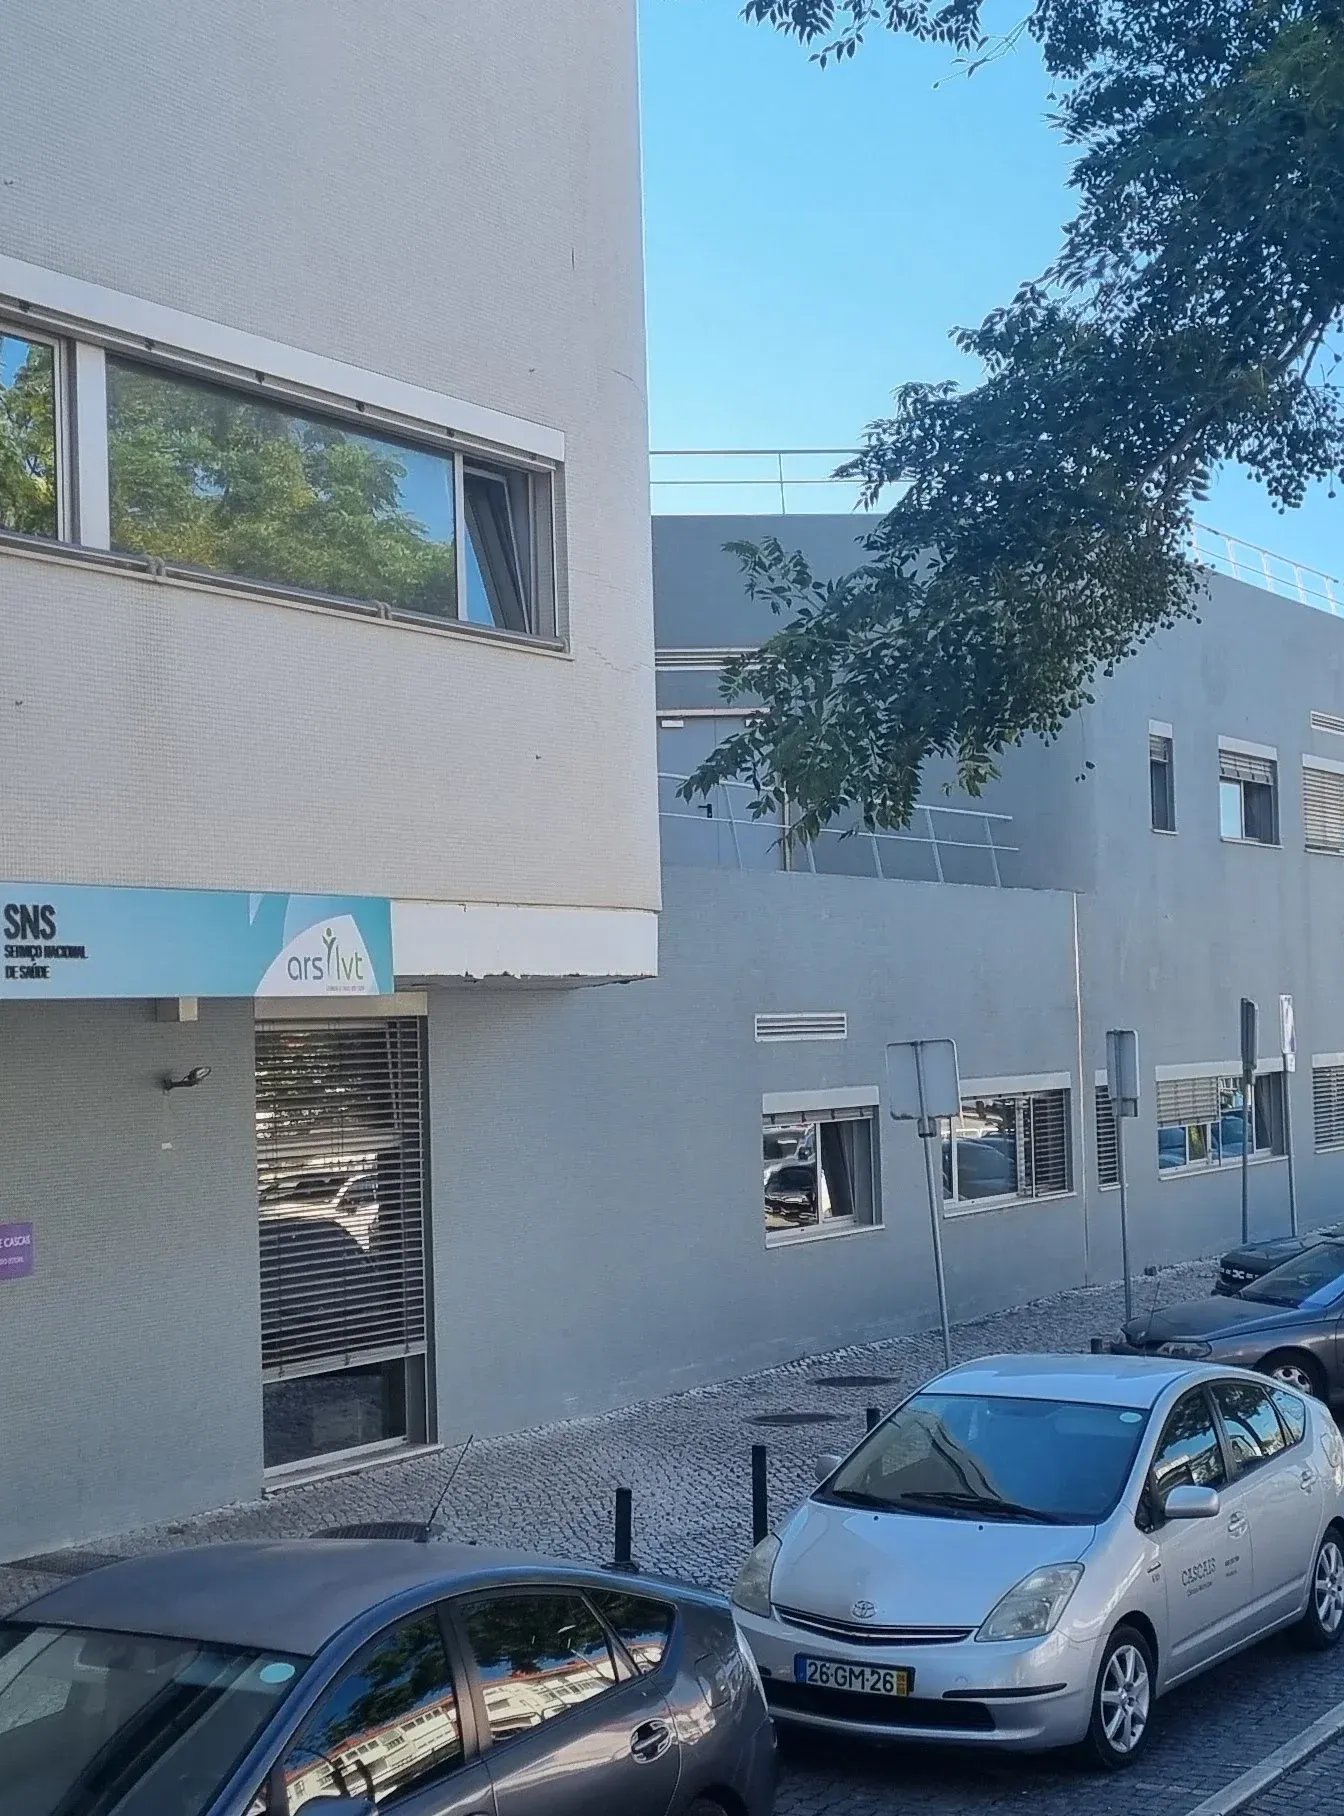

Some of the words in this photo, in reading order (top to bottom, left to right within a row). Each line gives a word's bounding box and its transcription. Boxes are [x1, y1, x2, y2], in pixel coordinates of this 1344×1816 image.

[3, 903, 57, 941] SNS
[4, 944, 43, 961] SERVIÇO
[44, 945, 88, 959] NACIONAL
[5, 965, 19, 979] DE
[19, 962, 51, 980] SAÚDE
[1181, 1557, 1216, 1586] CASCAIS
